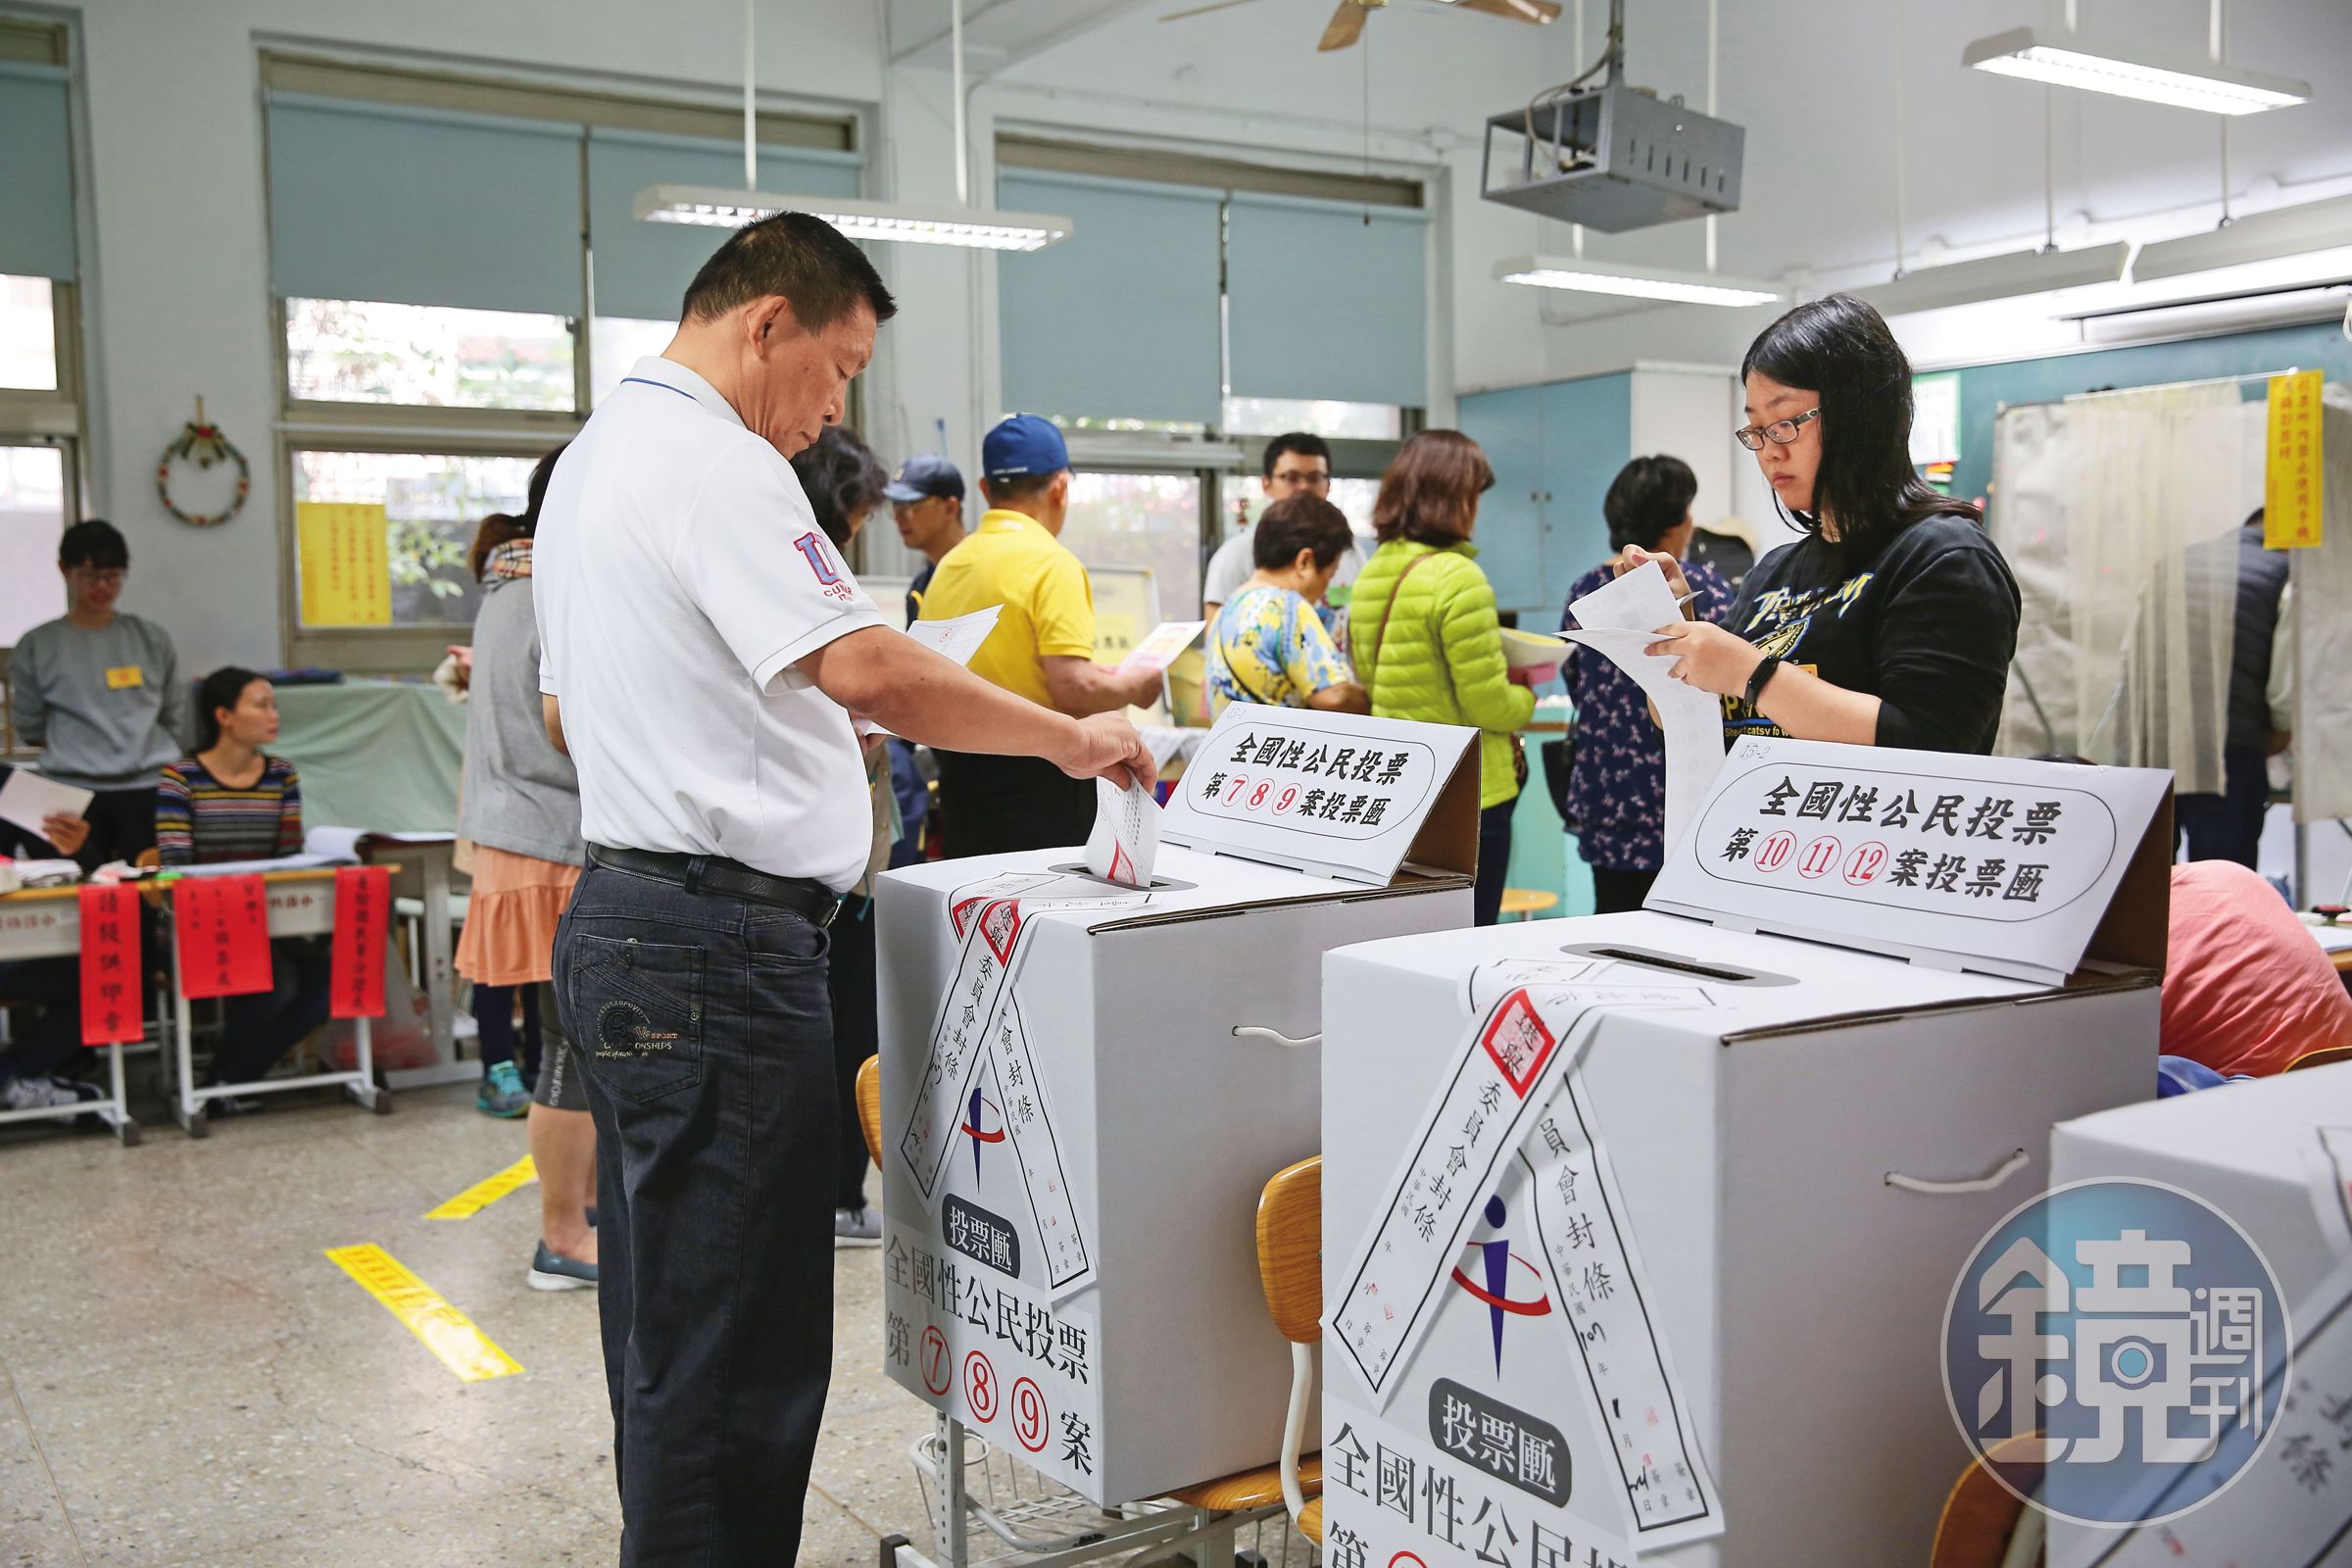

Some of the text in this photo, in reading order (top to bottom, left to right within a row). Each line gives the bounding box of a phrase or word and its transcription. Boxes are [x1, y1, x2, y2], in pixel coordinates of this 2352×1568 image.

[1230, 732, 1409, 785] 全國性公民投票
[1759, 776, 2062, 847] 全國性公民投票
[950, 1204, 1012, 1273] 投票匭
[886, 1234, 1088, 1385] 全國性公民投票
[1443, 1394, 1558, 1494] 投票匭
[1329, 1422, 1629, 1568] 全國性公民
